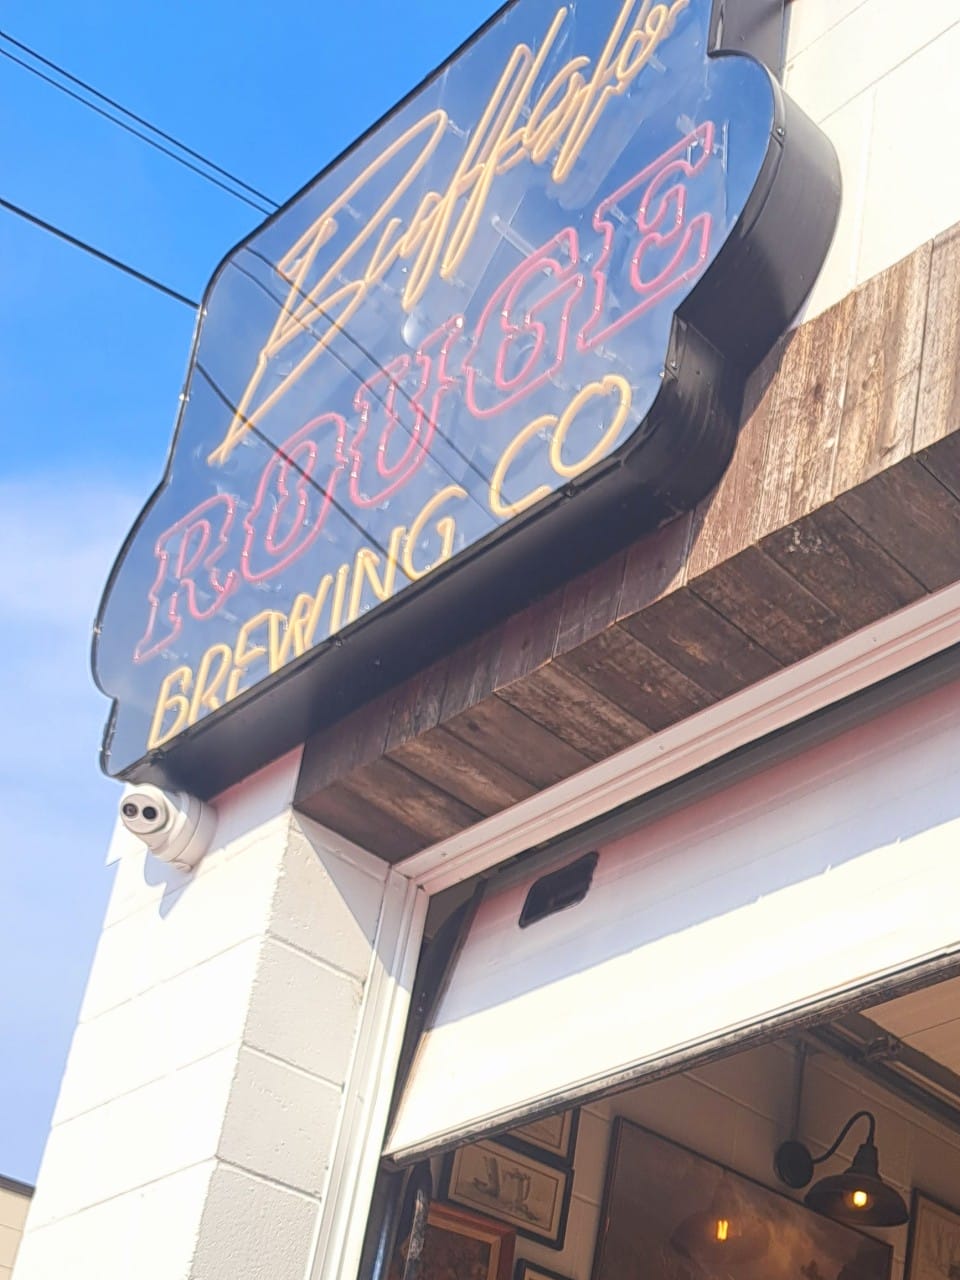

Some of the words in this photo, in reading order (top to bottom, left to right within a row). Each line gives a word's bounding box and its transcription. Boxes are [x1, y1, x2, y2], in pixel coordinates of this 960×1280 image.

[133, 120, 714, 664] ROUGE
[147, 484, 468, 751] BREWING
[489, 374, 633, 520] CO
